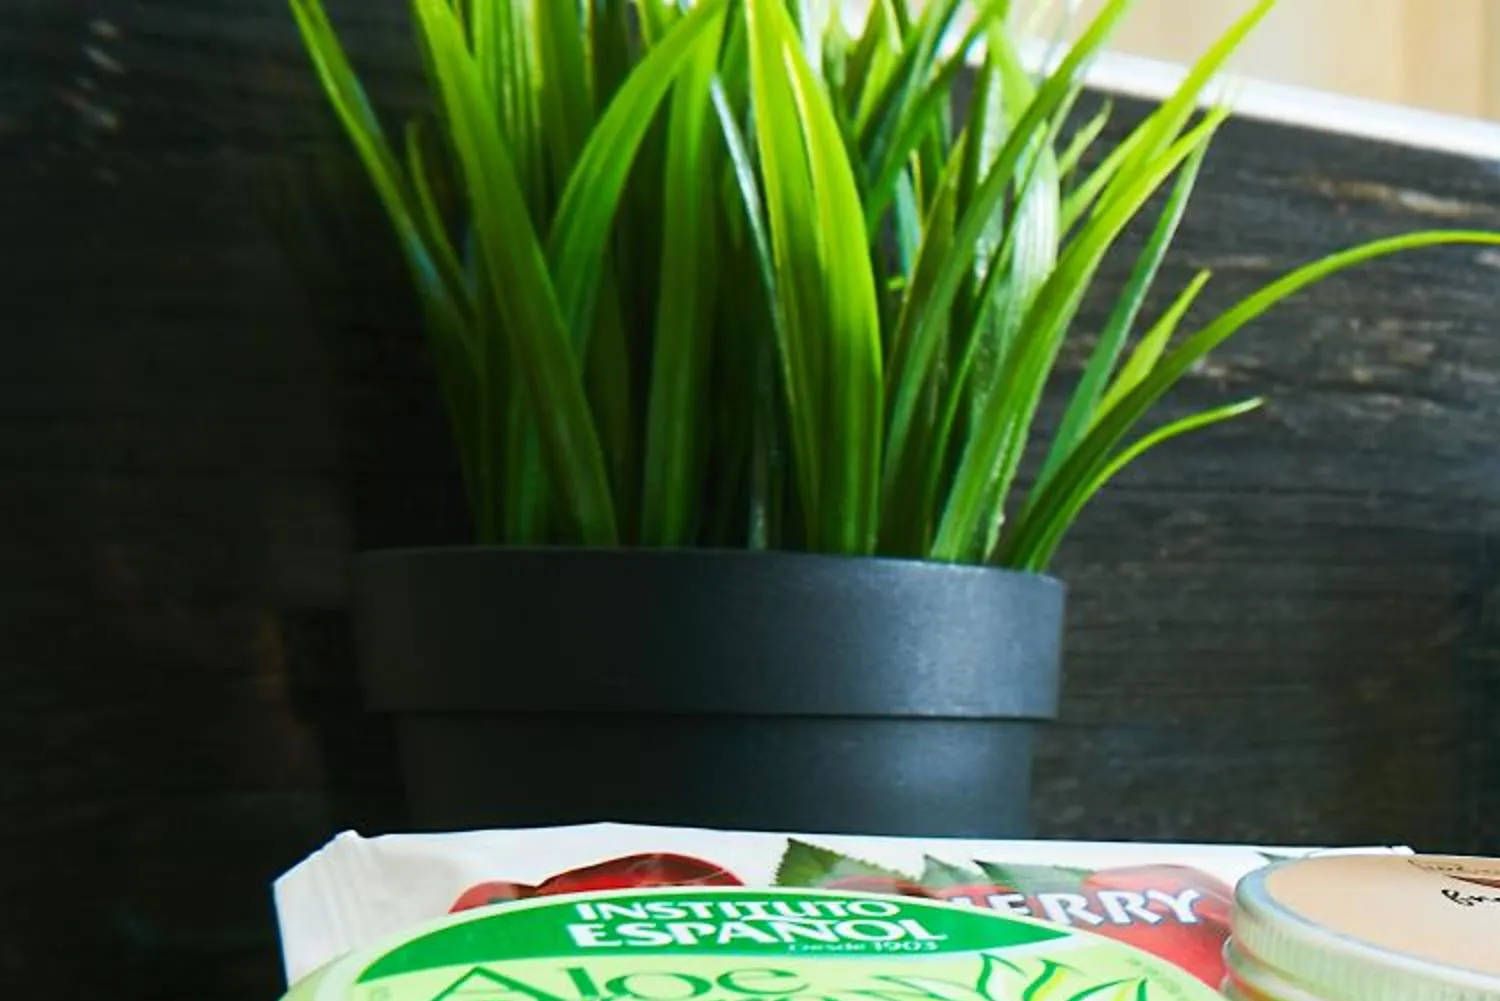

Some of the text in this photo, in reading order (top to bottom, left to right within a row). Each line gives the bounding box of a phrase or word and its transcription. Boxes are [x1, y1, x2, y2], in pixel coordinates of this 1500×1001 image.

[575, 899, 901, 921] INSTITUTO
[947, 888, 1202, 928] ERRY
[566, 916, 949, 948] ESPAÑOL
